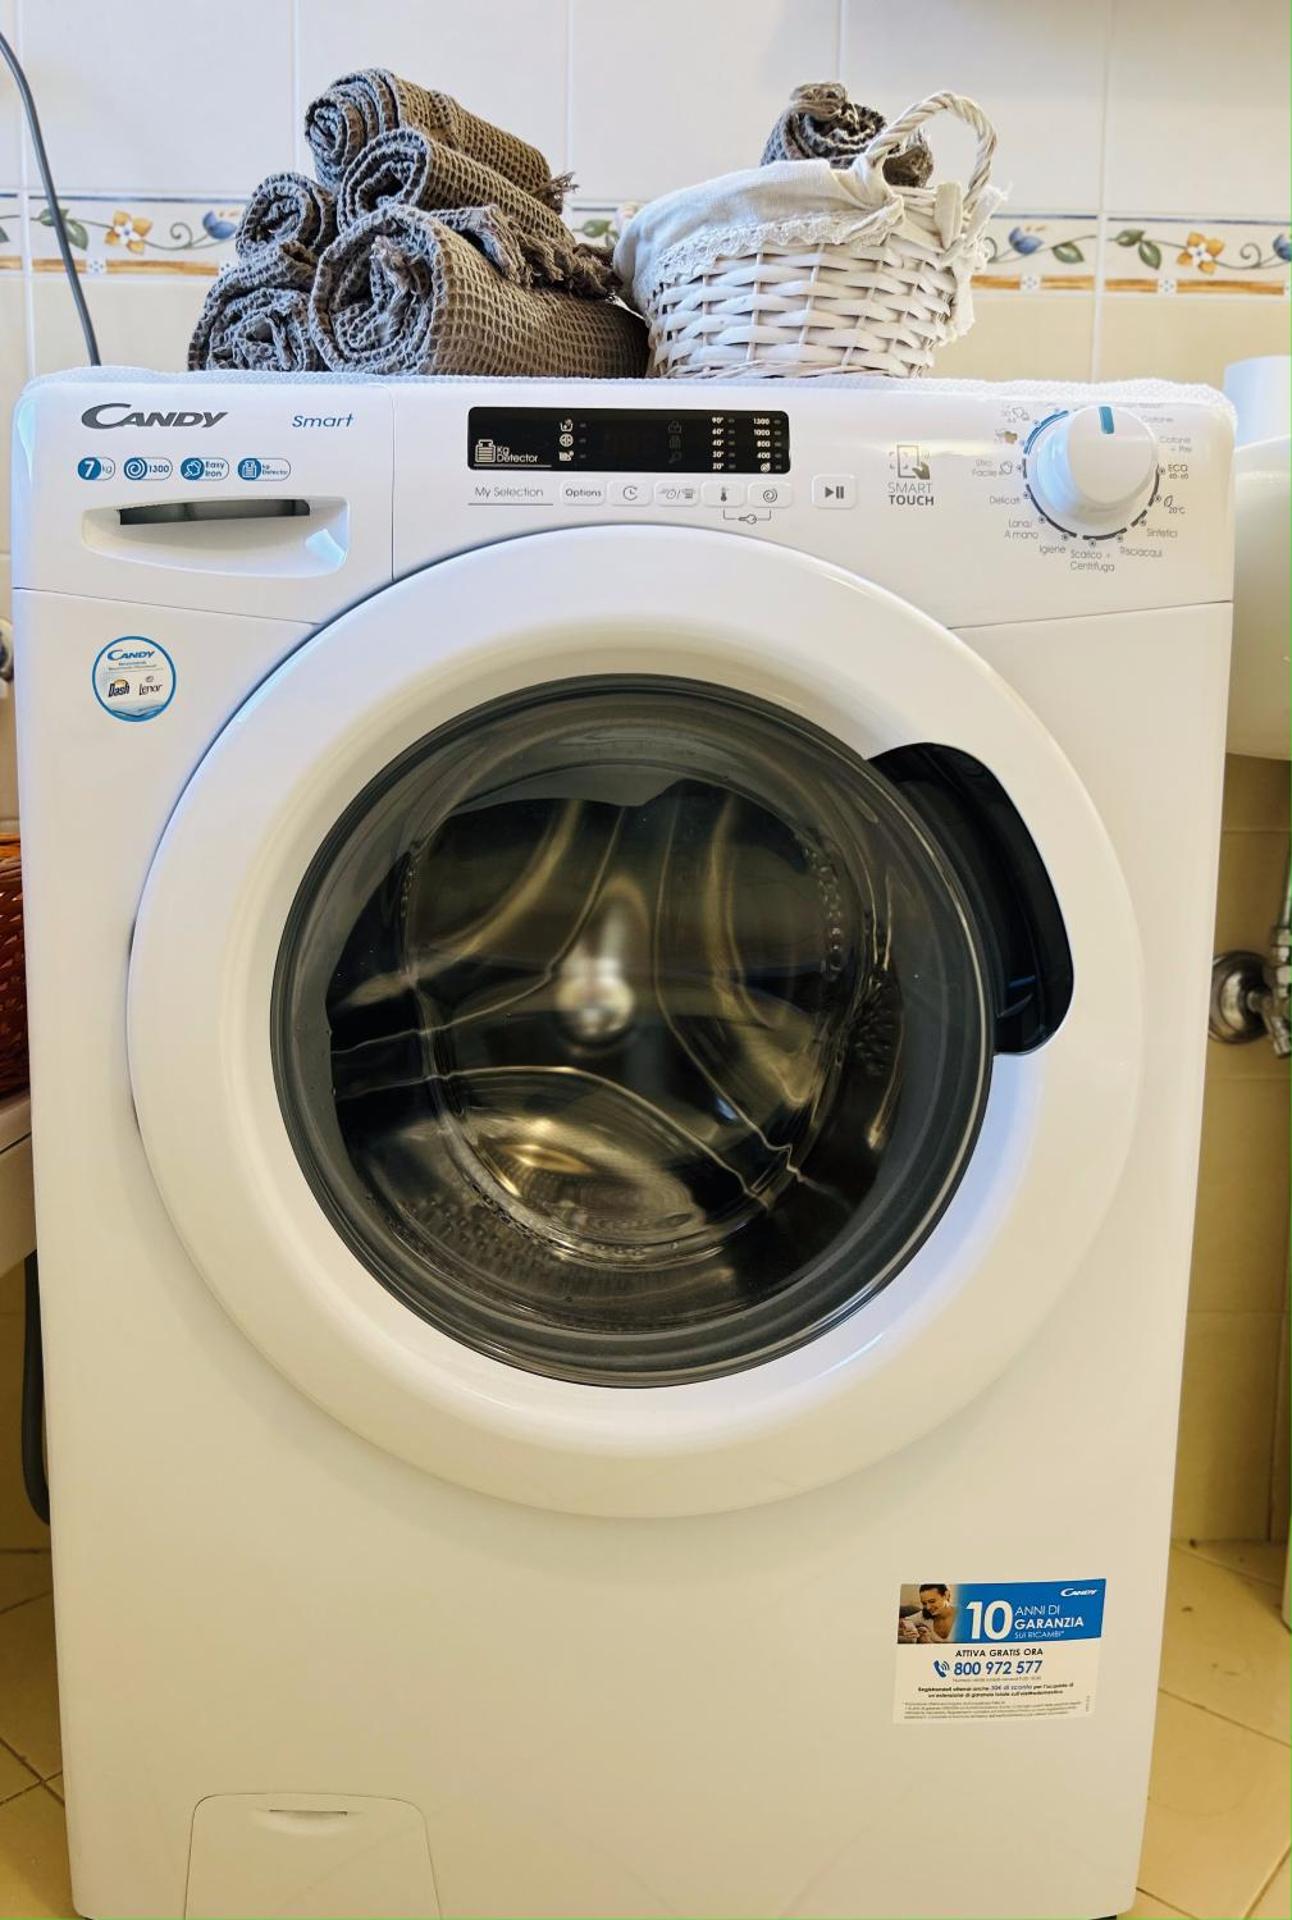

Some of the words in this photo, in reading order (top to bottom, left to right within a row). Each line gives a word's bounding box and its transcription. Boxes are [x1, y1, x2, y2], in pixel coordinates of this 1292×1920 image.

[81, 403, 228, 429] CANDY
[292, 413, 354, 428] Smart
[497, 446, 510, 457] Kg
[497, 453, 539, 463] Detector
[84, 461, 96, 478] 7
[149, 464, 169, 473] 1300
[205, 461, 225, 469] Easy
[1168, 464, 1188, 472] ECO
[205, 469, 222, 477] Iron
[474, 487, 491, 498] My
[493, 487, 544, 497] Selection
[888, 481, 932, 494] SMART
[565, 488, 602, 500] Options
[888, 494, 935, 506] TOUCH
[989, 495, 1021, 505] Delicati
[1146, 528, 1178, 538] Sintetici
[1039, 544, 1067, 556] Igiene
[1070, 549, 1103, 560] Scarico
[1070, 561, 1116, 573] Centrifuga
[107, 649, 155, 661] CANDY
[108, 682, 130, 698] Dash
[138, 683, 164, 696] Lenor
[1014, 1605, 1046, 1616] ANNI
[1048, 1604, 1060, 1616] DI
[965, 1600, 1013, 1640] 10
[1014, 1616, 1085, 1630] GARANZIA
[955, 1649, 986, 1657] ATTIVA
[989, 1648, 1020, 1657] GRATIS
[1023, 1648, 1043, 1656] ORA
[954, 1661, 981, 1675] 800
[986, 1661, 1012, 1675] 972
[1016, 1660, 1043, 1674] 577
